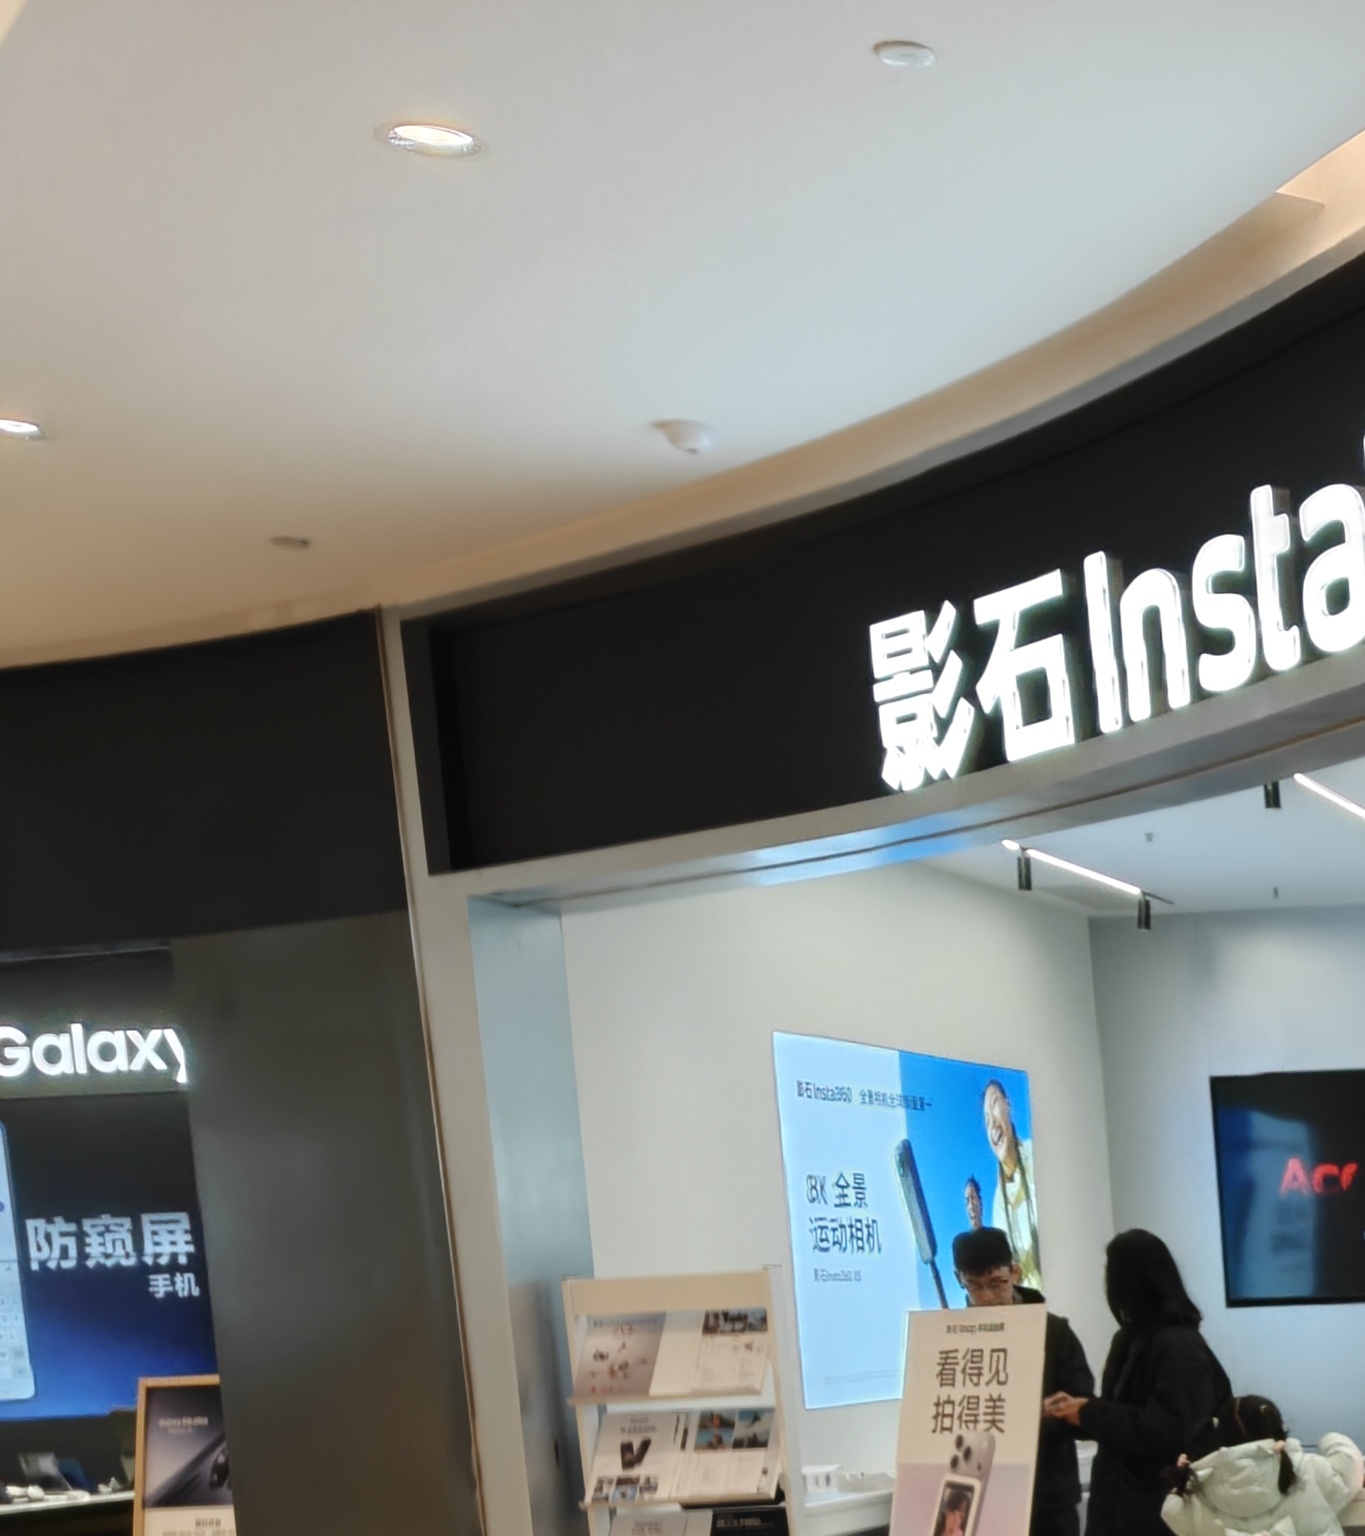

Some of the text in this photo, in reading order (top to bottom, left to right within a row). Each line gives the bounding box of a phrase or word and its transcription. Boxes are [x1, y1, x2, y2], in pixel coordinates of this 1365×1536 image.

[0, 1022, 188, 1084] Galaxy
[833, 1172, 868, 1208] 全景
[25, 1212, 195, 1271] 防窥屏
[808, 1216, 882, 1254] 运动相机
[148, 1272, 200, 1298] 手机
[936, 1347, 1009, 1388] 看得见
[931, 1392, 1006, 1434] 拍得美
